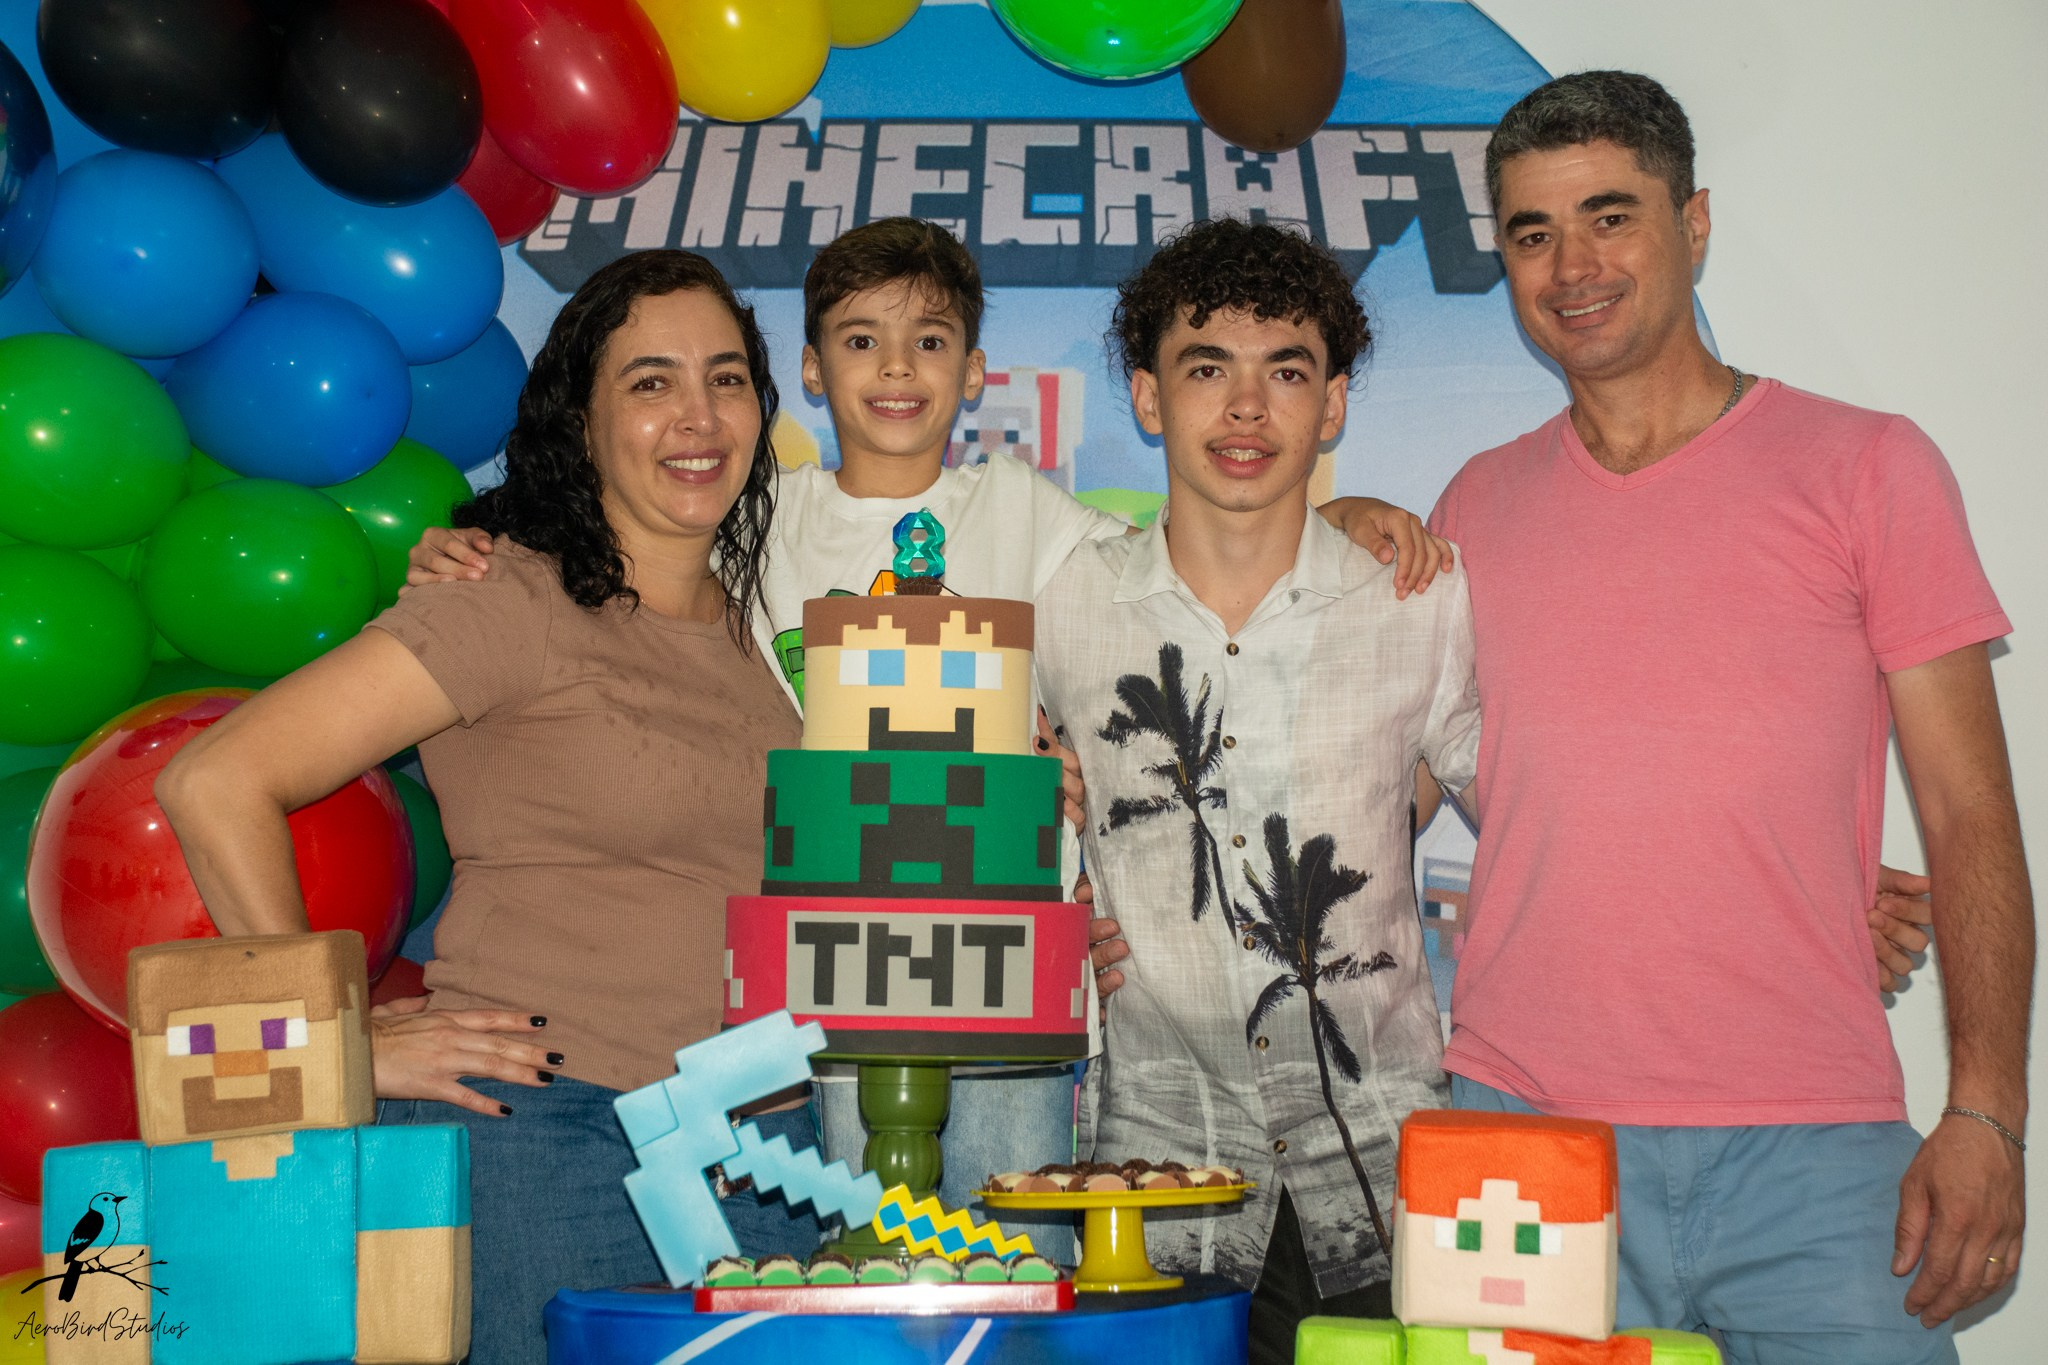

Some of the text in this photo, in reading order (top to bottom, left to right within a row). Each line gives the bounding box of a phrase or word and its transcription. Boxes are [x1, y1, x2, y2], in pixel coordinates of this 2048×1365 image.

[524, 122, 1501, 254] MINECRAFT
[892, 511, 946, 580] 8
[794, 921, 1027, 1008] TNT
